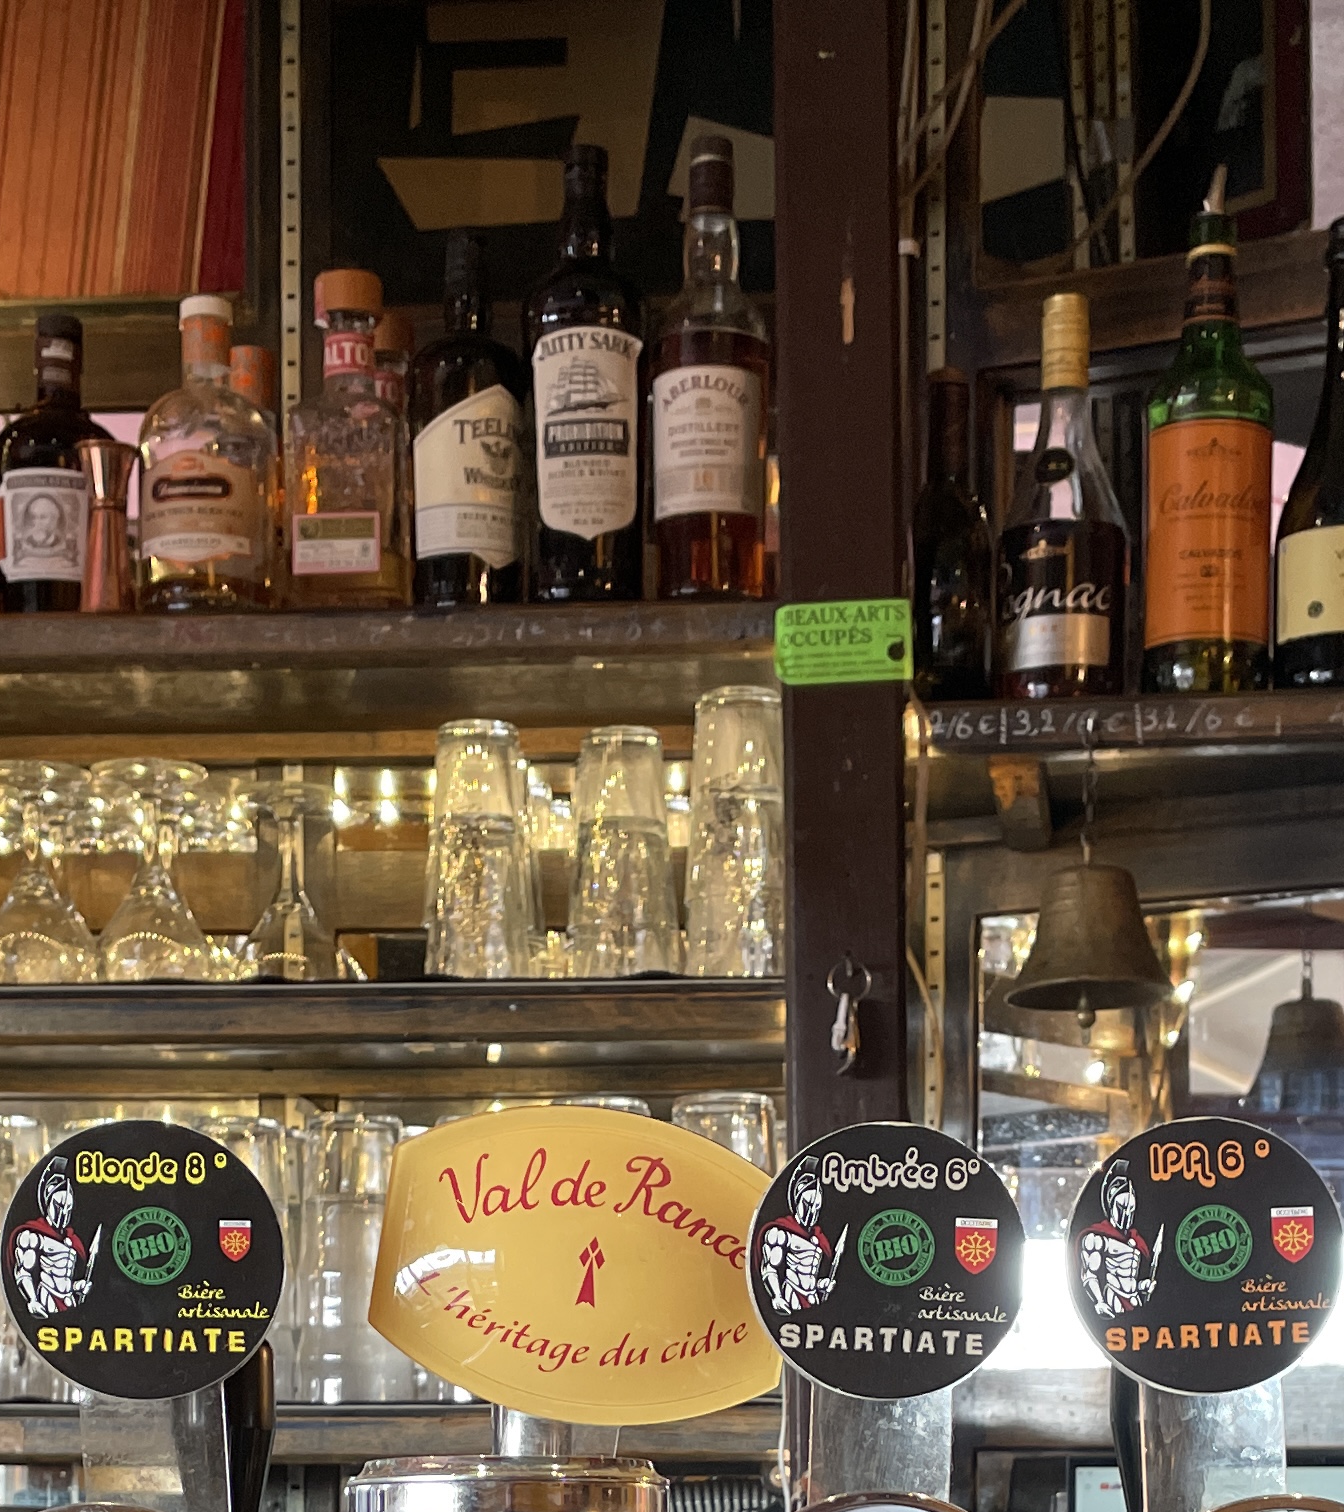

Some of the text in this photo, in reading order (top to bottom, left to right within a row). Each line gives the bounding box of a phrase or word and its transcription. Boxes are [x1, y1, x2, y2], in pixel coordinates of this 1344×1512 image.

[588, 331, 633, 358] SARK
[76, 1150, 177, 1192] Blonde
[822, 1147, 938, 1195] Ambrée
[1149, 1141, 1216, 1190] IPA
[438, 1148, 748, 1271] Val de Rance
[128, 1231, 176, 1262] BIO
[873, 1233, 920, 1263] BIO
[1190, 1227, 1238, 1260] BIO
[177, 1280, 226, 1300] Bière
[919, 1283, 967, 1303] Bière
[1240, 1273, 1288, 1294] Bière
[177, 1301, 270, 1319] artisanale
[917, 1305, 1008, 1323] artisanale
[1241, 1292, 1333, 1313] artisanale
[38, 1326, 248, 1354] SPARTIATE
[598, 1332, 649, 1369] du
[660, 1319, 749, 1365] cidre
[779, 1323, 984, 1357] SPARTIATE
[1106, 1321, 1311, 1351] SPARTIATE
